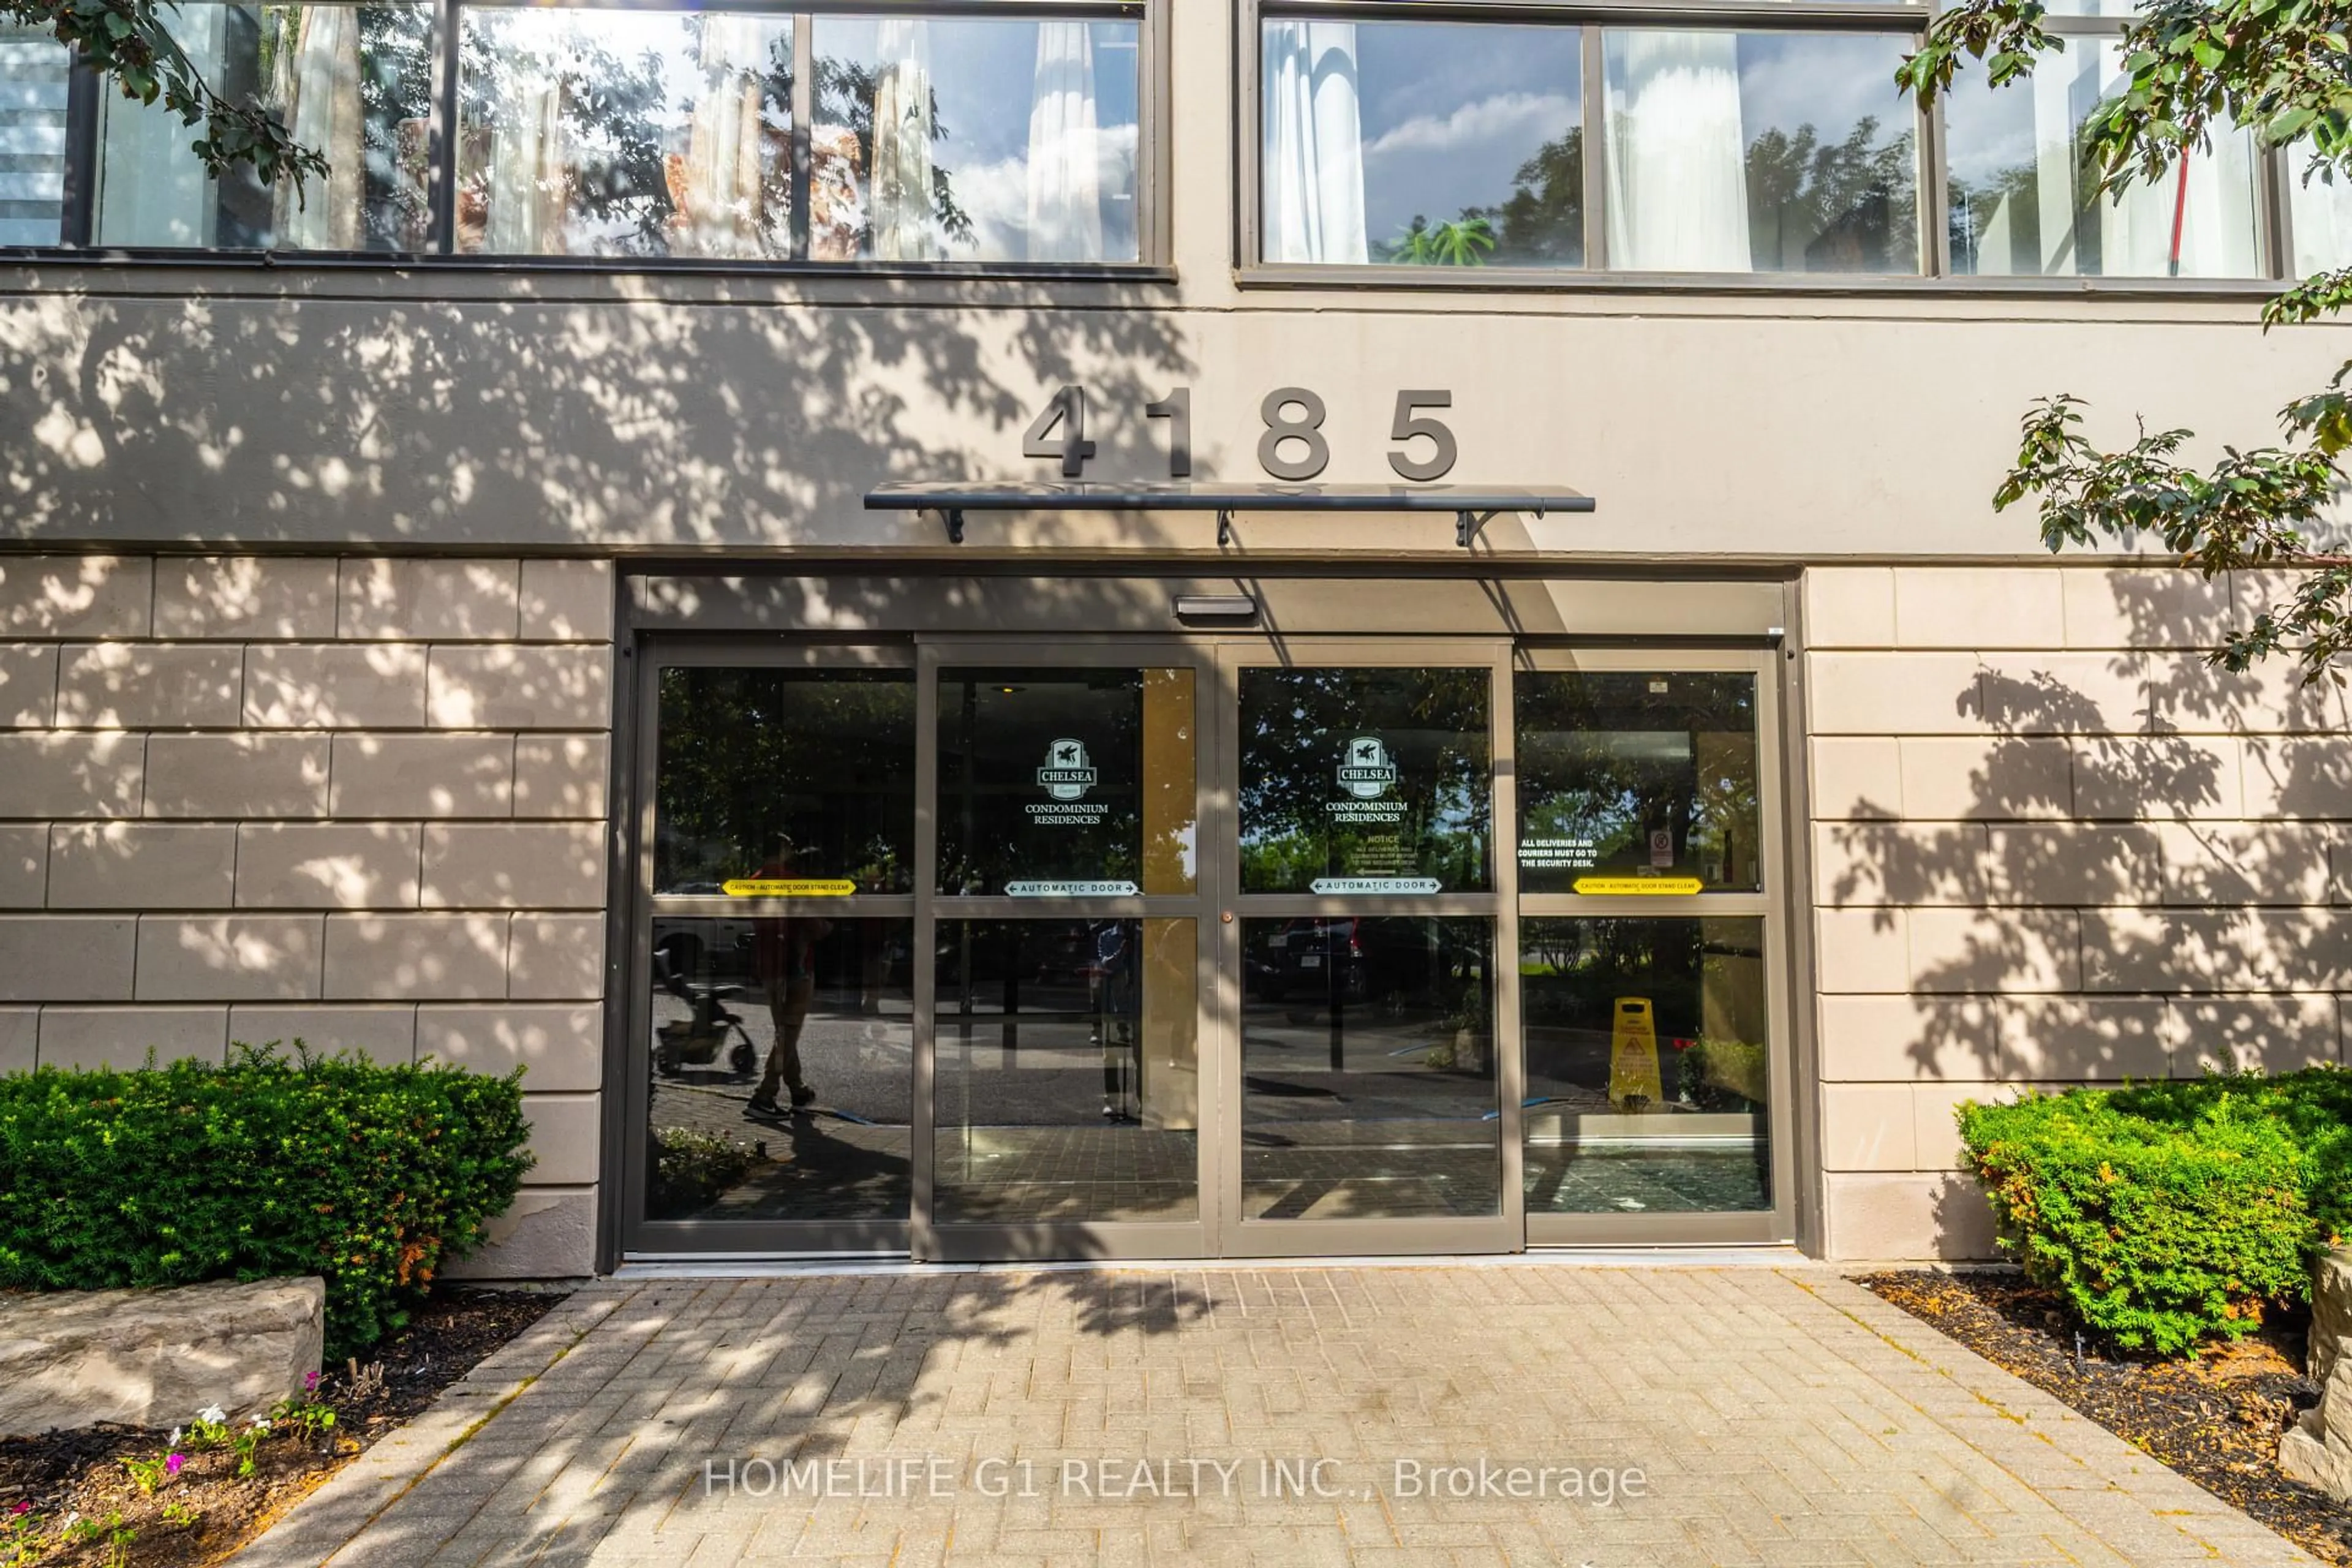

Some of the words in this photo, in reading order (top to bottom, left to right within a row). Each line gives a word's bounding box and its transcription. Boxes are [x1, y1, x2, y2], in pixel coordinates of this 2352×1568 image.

[1023, 385, 1458, 482] 4185
[1041, 771, 1093, 782] CHELSEA
[1341, 769, 1391, 780] CHELSEA
[1025, 804, 1109, 813] CONDOMINIUM
[1325, 802, 1408, 811] CONDOMINIUM
[1034, 815, 1101, 824] RESIDENCES
[1335, 813, 1400, 822] RESIDENCES
[1368, 835, 1400, 843] NOTICE
[1521, 839, 1535, 847] ALL
[1536, 839, 1577, 847] DELIVERIES
[1578, 839, 1593, 847] AND
